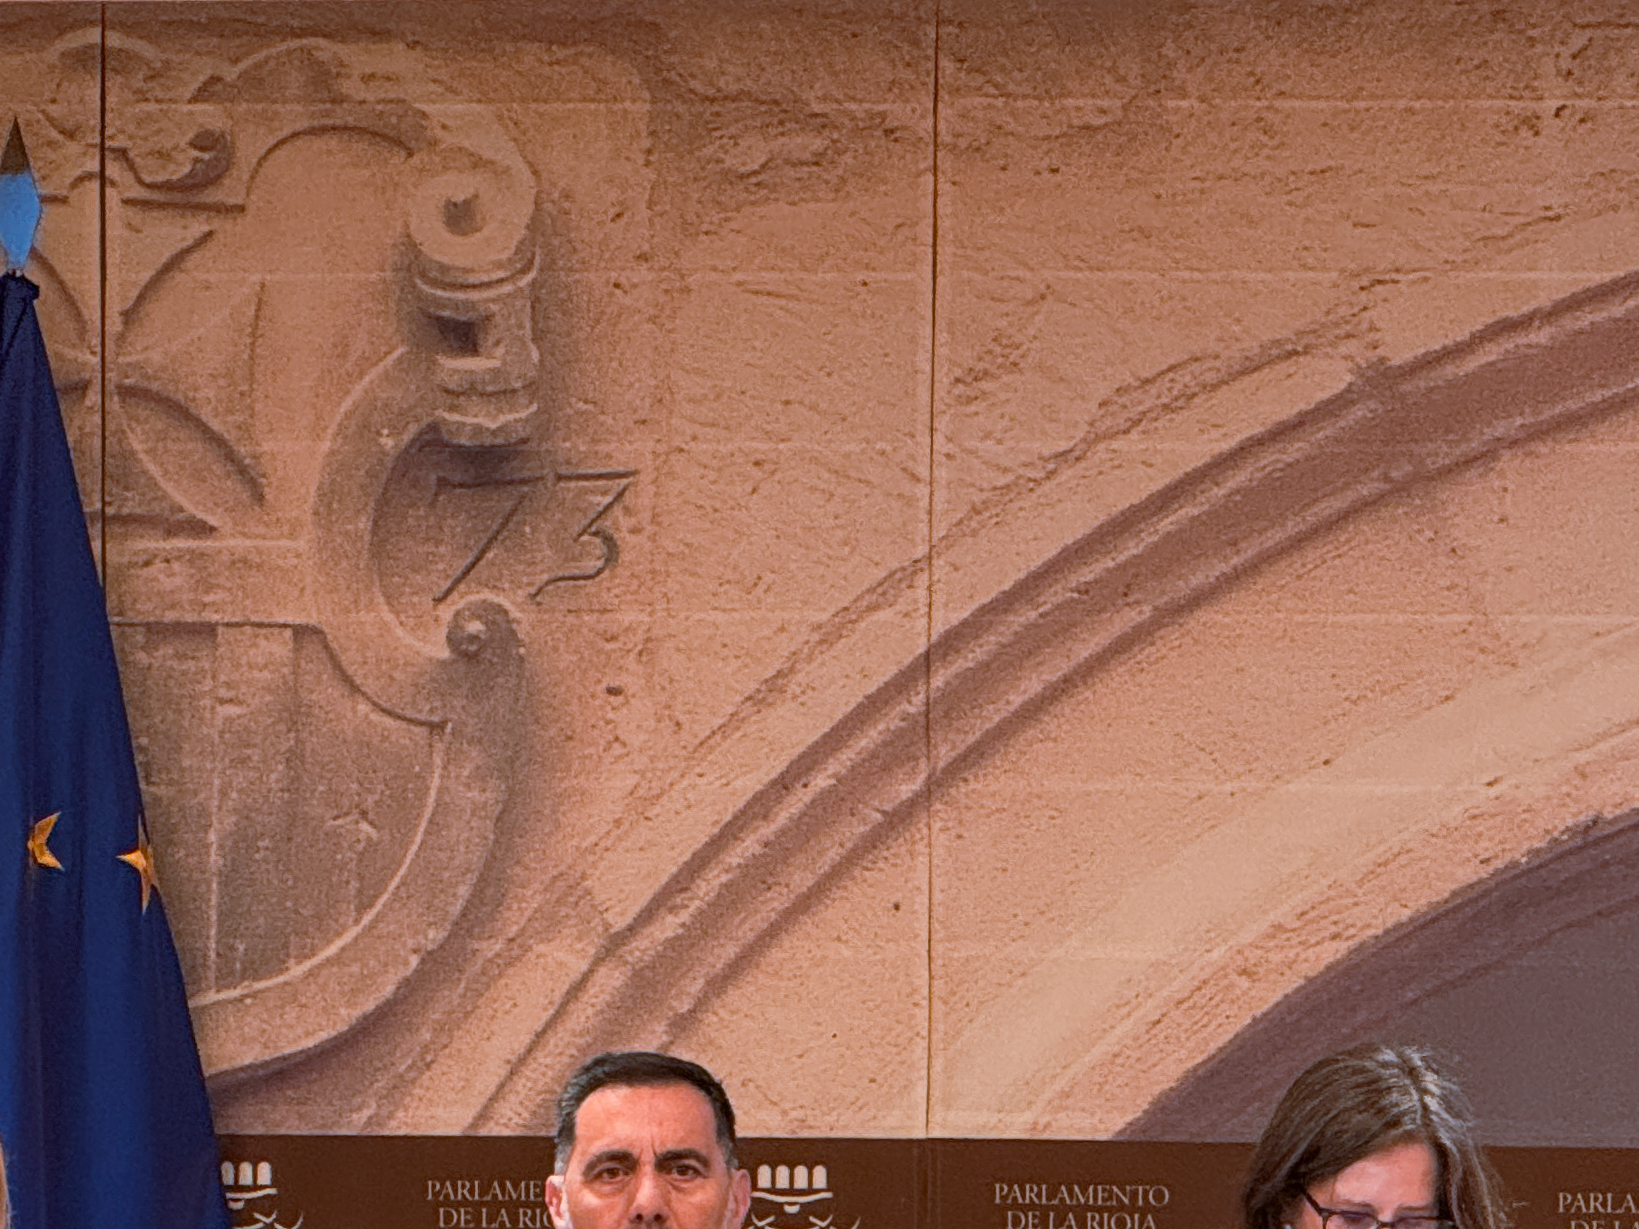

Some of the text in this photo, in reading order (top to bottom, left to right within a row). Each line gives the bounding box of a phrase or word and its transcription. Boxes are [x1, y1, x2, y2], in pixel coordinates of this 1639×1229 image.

[426, 1180, 543, 1201] PARLAME
[994, 1183, 1170, 1207] PARLAMENTO
[1557, 1191, 1639, 1213] PARLA
[438, 1207, 475, 1229] DE
[481, 1207, 512, 1229] LA
